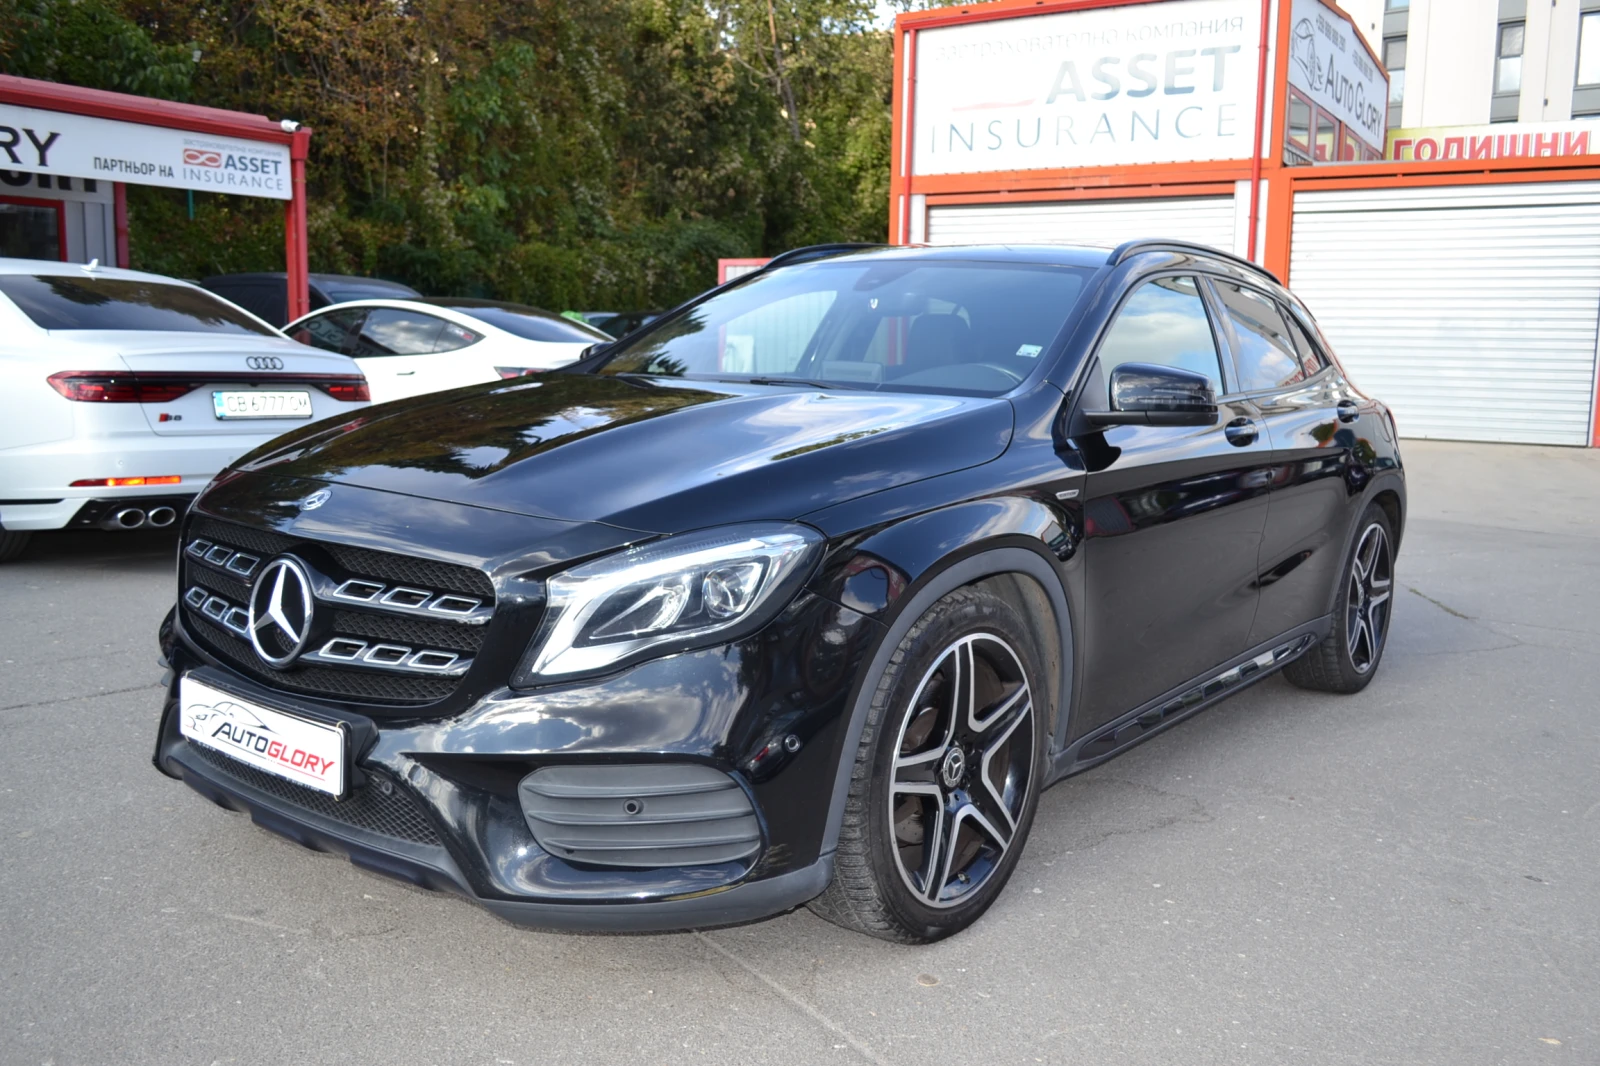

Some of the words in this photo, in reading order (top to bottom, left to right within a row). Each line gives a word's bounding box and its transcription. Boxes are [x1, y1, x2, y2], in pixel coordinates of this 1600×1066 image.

[1045, 44, 1241, 104] ASSET
[931, 103, 1237, 153] INSURANCE
[93, 156, 156, 177] ПАРТНЬОР
[159, 164, 175, 178] НА
[183, 168, 283, 191] INSURANCE
[224, 154, 282, 175] ASSET
[211, 722, 335, 775] AUTOGLORY
